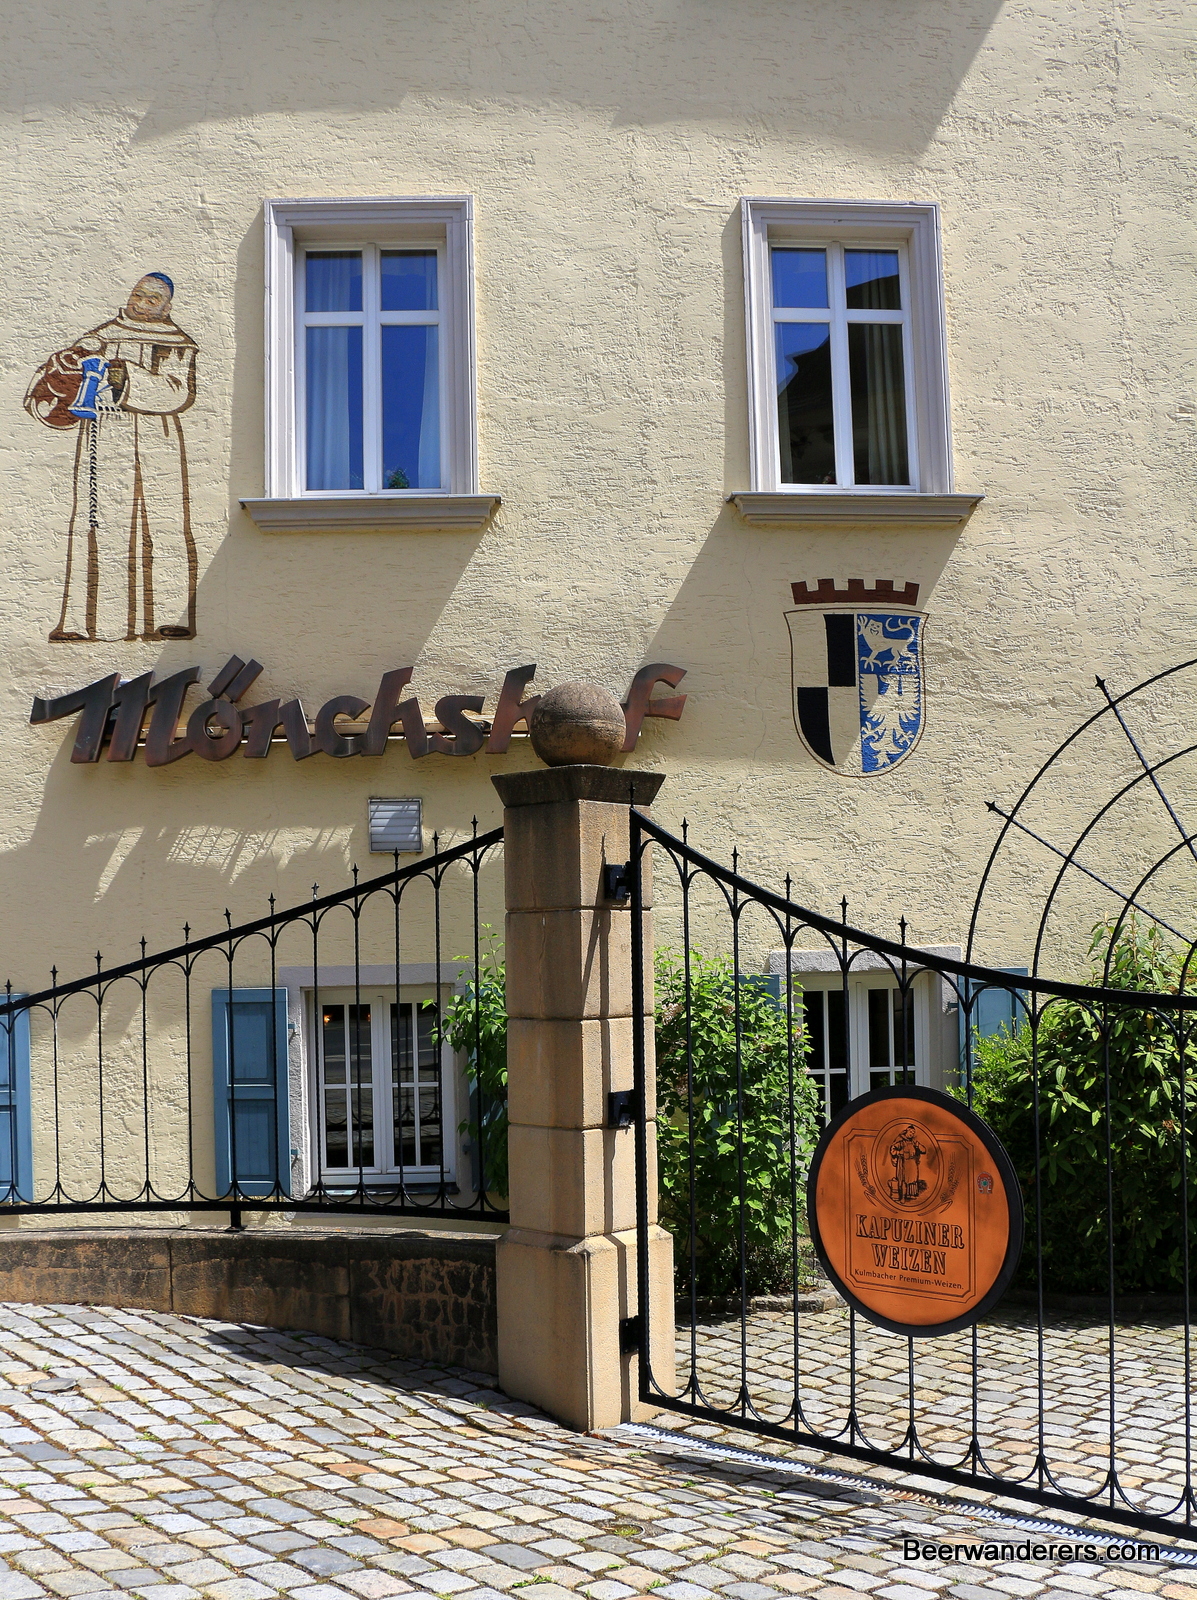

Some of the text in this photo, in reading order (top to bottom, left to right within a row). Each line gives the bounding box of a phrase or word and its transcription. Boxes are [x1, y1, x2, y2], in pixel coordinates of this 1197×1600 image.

[31, 654, 687, 767] Mönchshf
[856, 1214, 965, 1249] KAPUZINER
[871, 1243, 946, 1275] WEIZEN
[854, 1268, 964, 1290] Kulmbacher Premium-Weizen.
